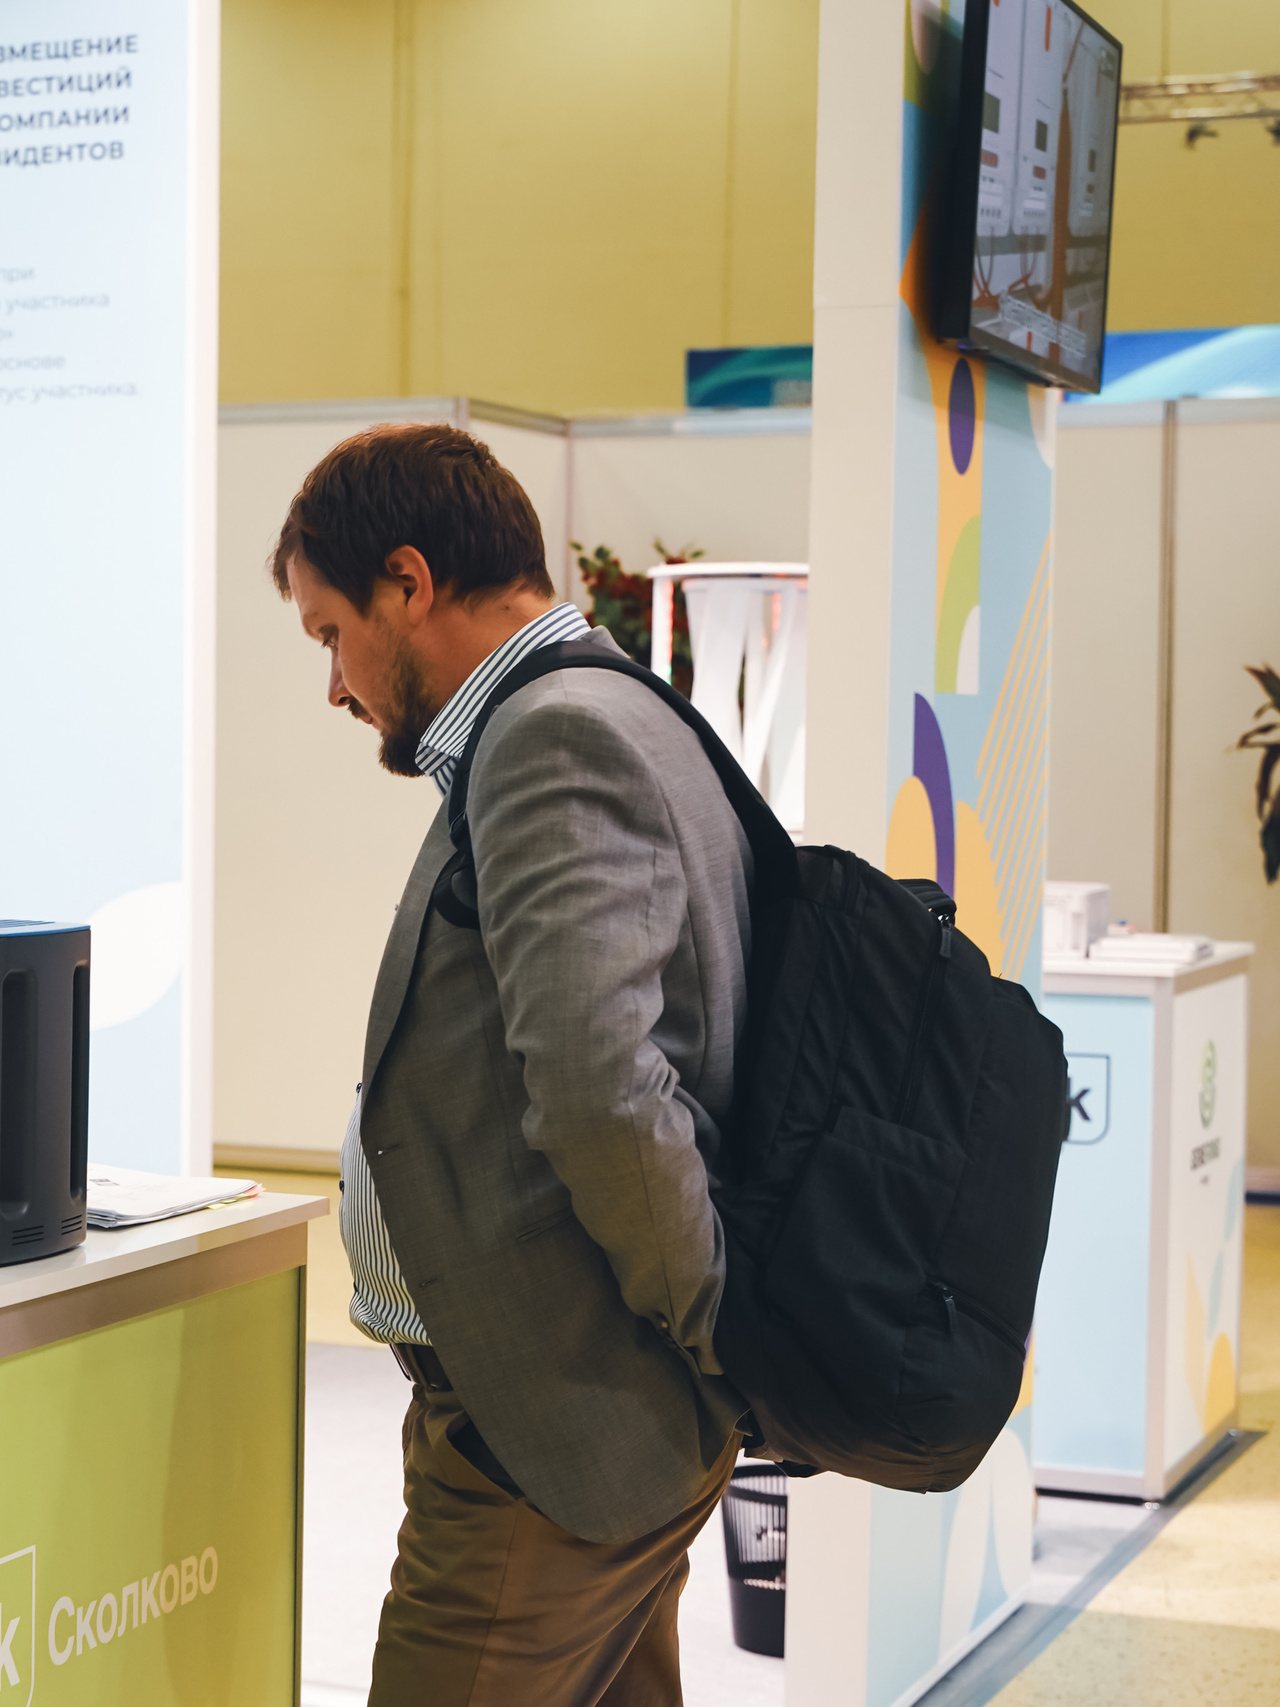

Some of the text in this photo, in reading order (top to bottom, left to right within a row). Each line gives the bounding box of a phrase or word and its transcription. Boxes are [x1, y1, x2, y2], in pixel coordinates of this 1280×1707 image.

[5, 294, 111, 315] участника
[1067, 1076, 1093, 1123] k
[48, 1546, 219, 1666] Сколково
